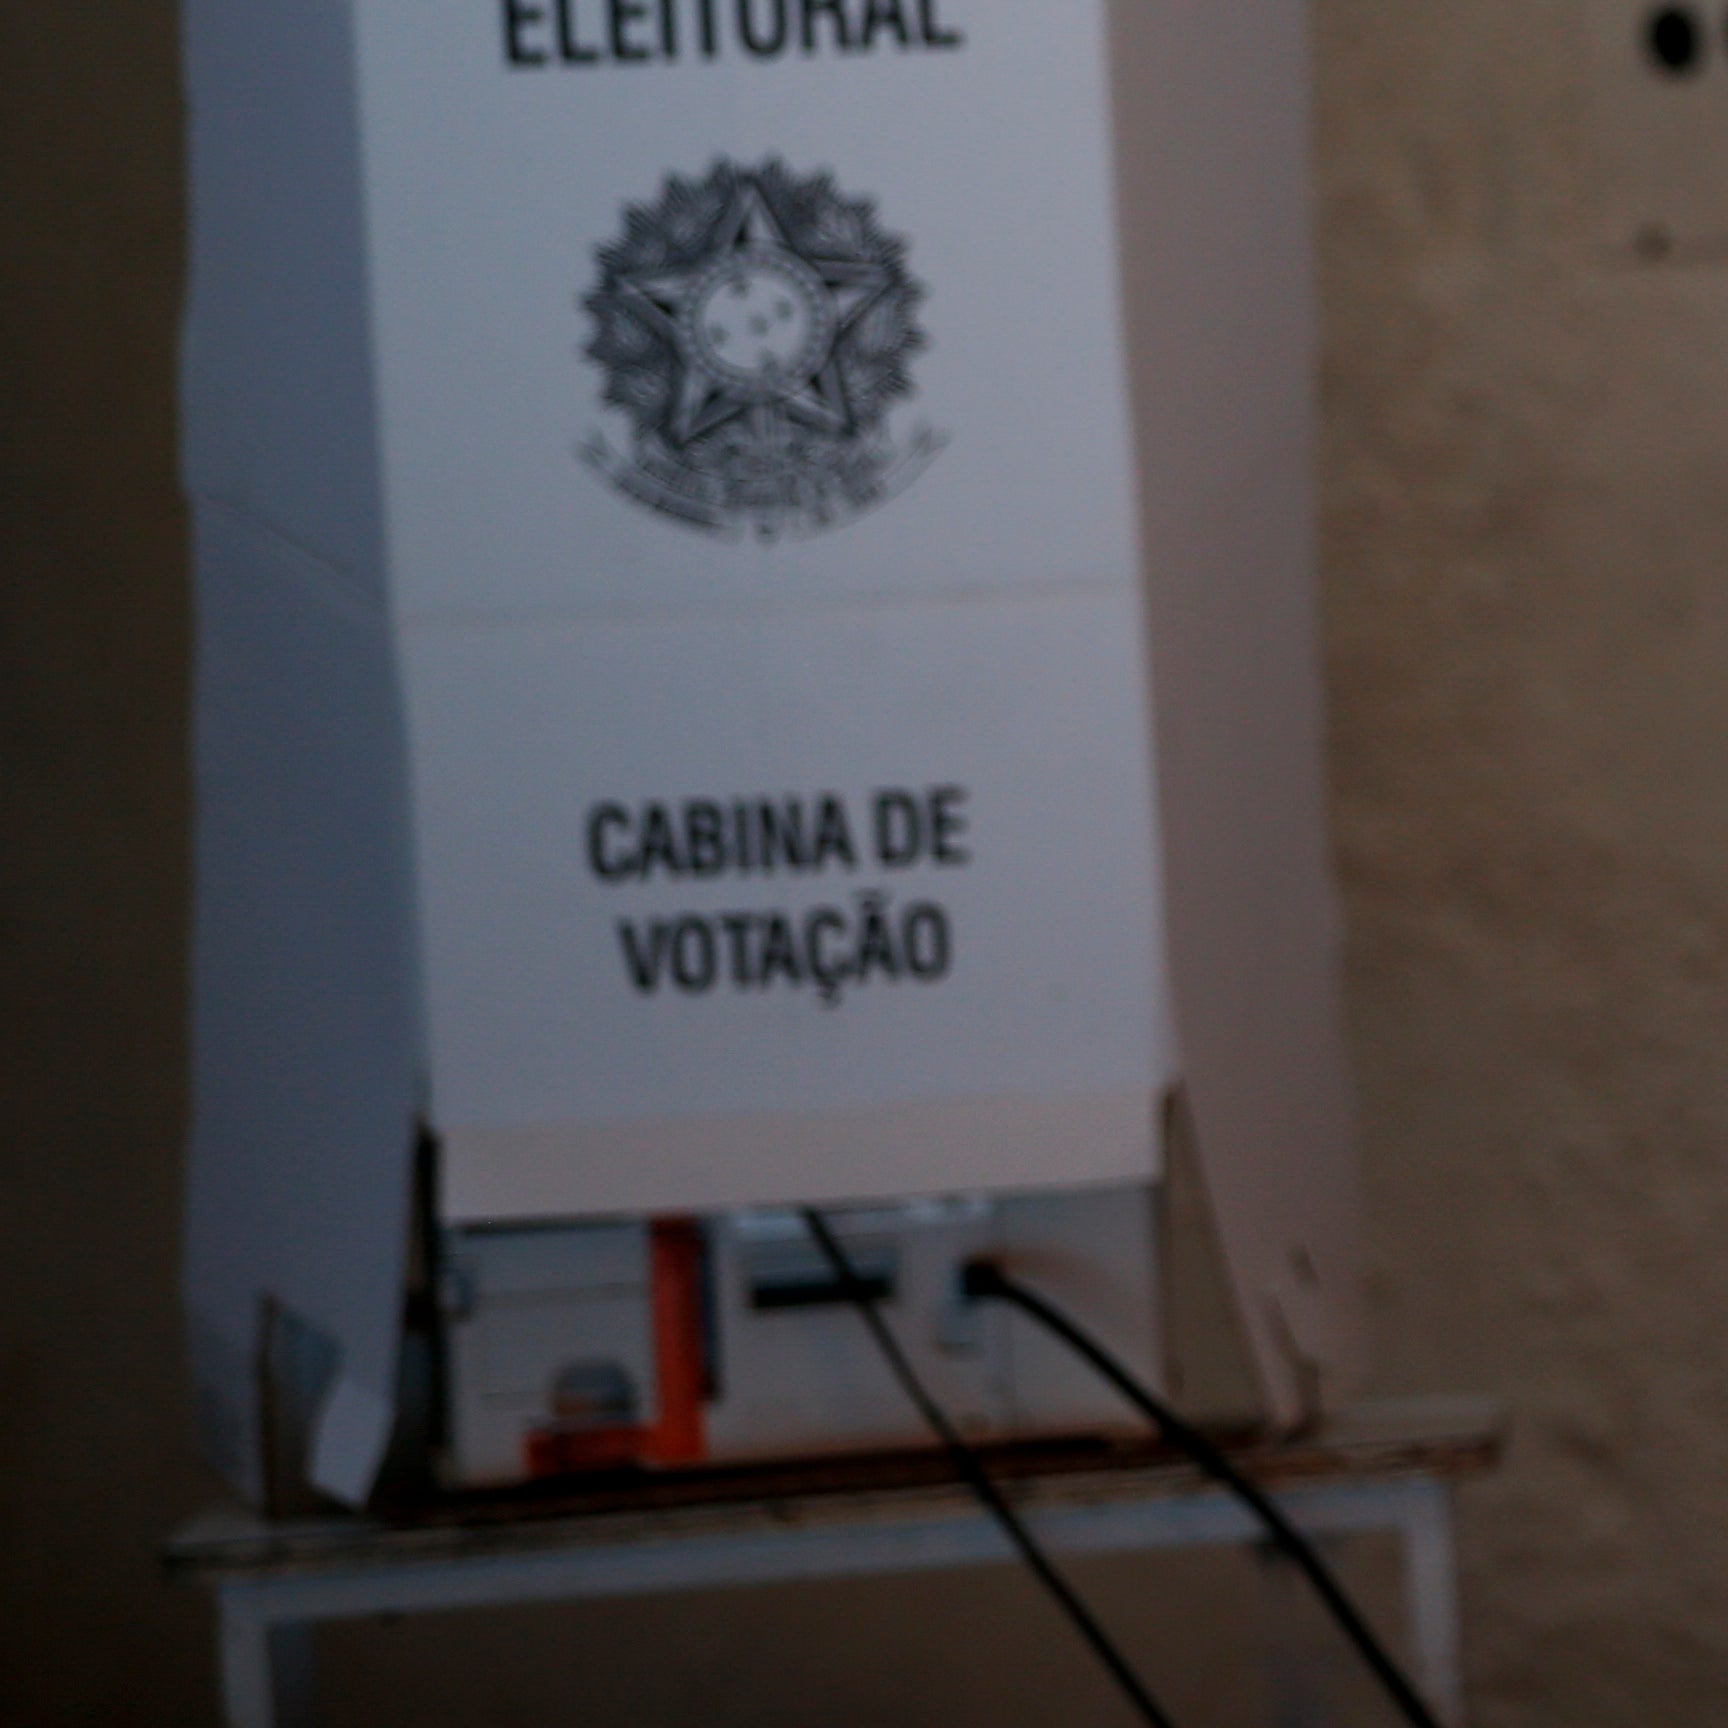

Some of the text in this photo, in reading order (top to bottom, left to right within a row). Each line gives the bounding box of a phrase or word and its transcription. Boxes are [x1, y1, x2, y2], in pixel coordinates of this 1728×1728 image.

[585, 783, 969, 884] CABINA DE
[618, 889, 955, 1007] VOTAÇÃO
